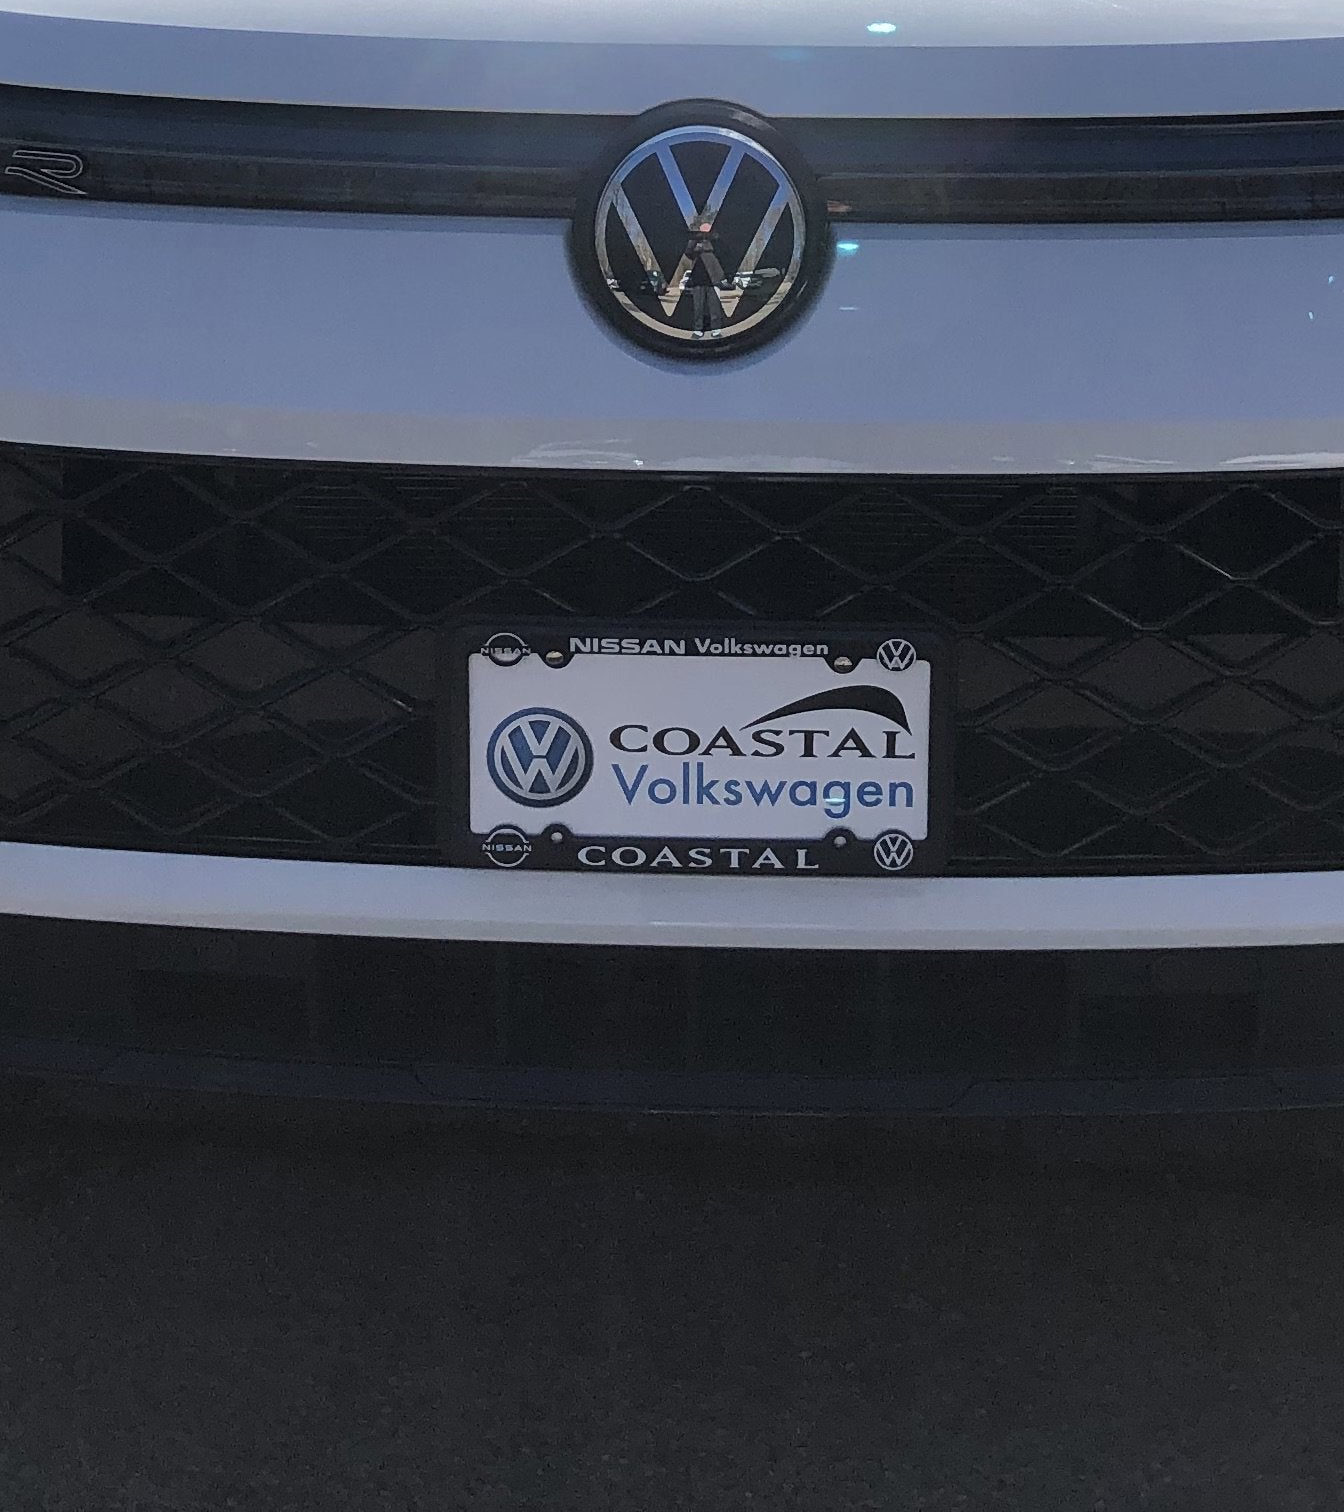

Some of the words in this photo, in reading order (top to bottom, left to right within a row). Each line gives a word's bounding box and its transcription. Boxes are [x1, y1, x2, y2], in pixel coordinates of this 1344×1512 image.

[481, 647, 531, 656] NISSAN
[569, 637, 686, 655] NISSAN
[694, 638, 830, 657] Volkswagen
[609, 725, 916, 759] COASTAL
[611, 762, 914, 818] Volkswagen
[482, 843, 532, 853] NISSAN
[577, 846, 819, 870] COASTAL
